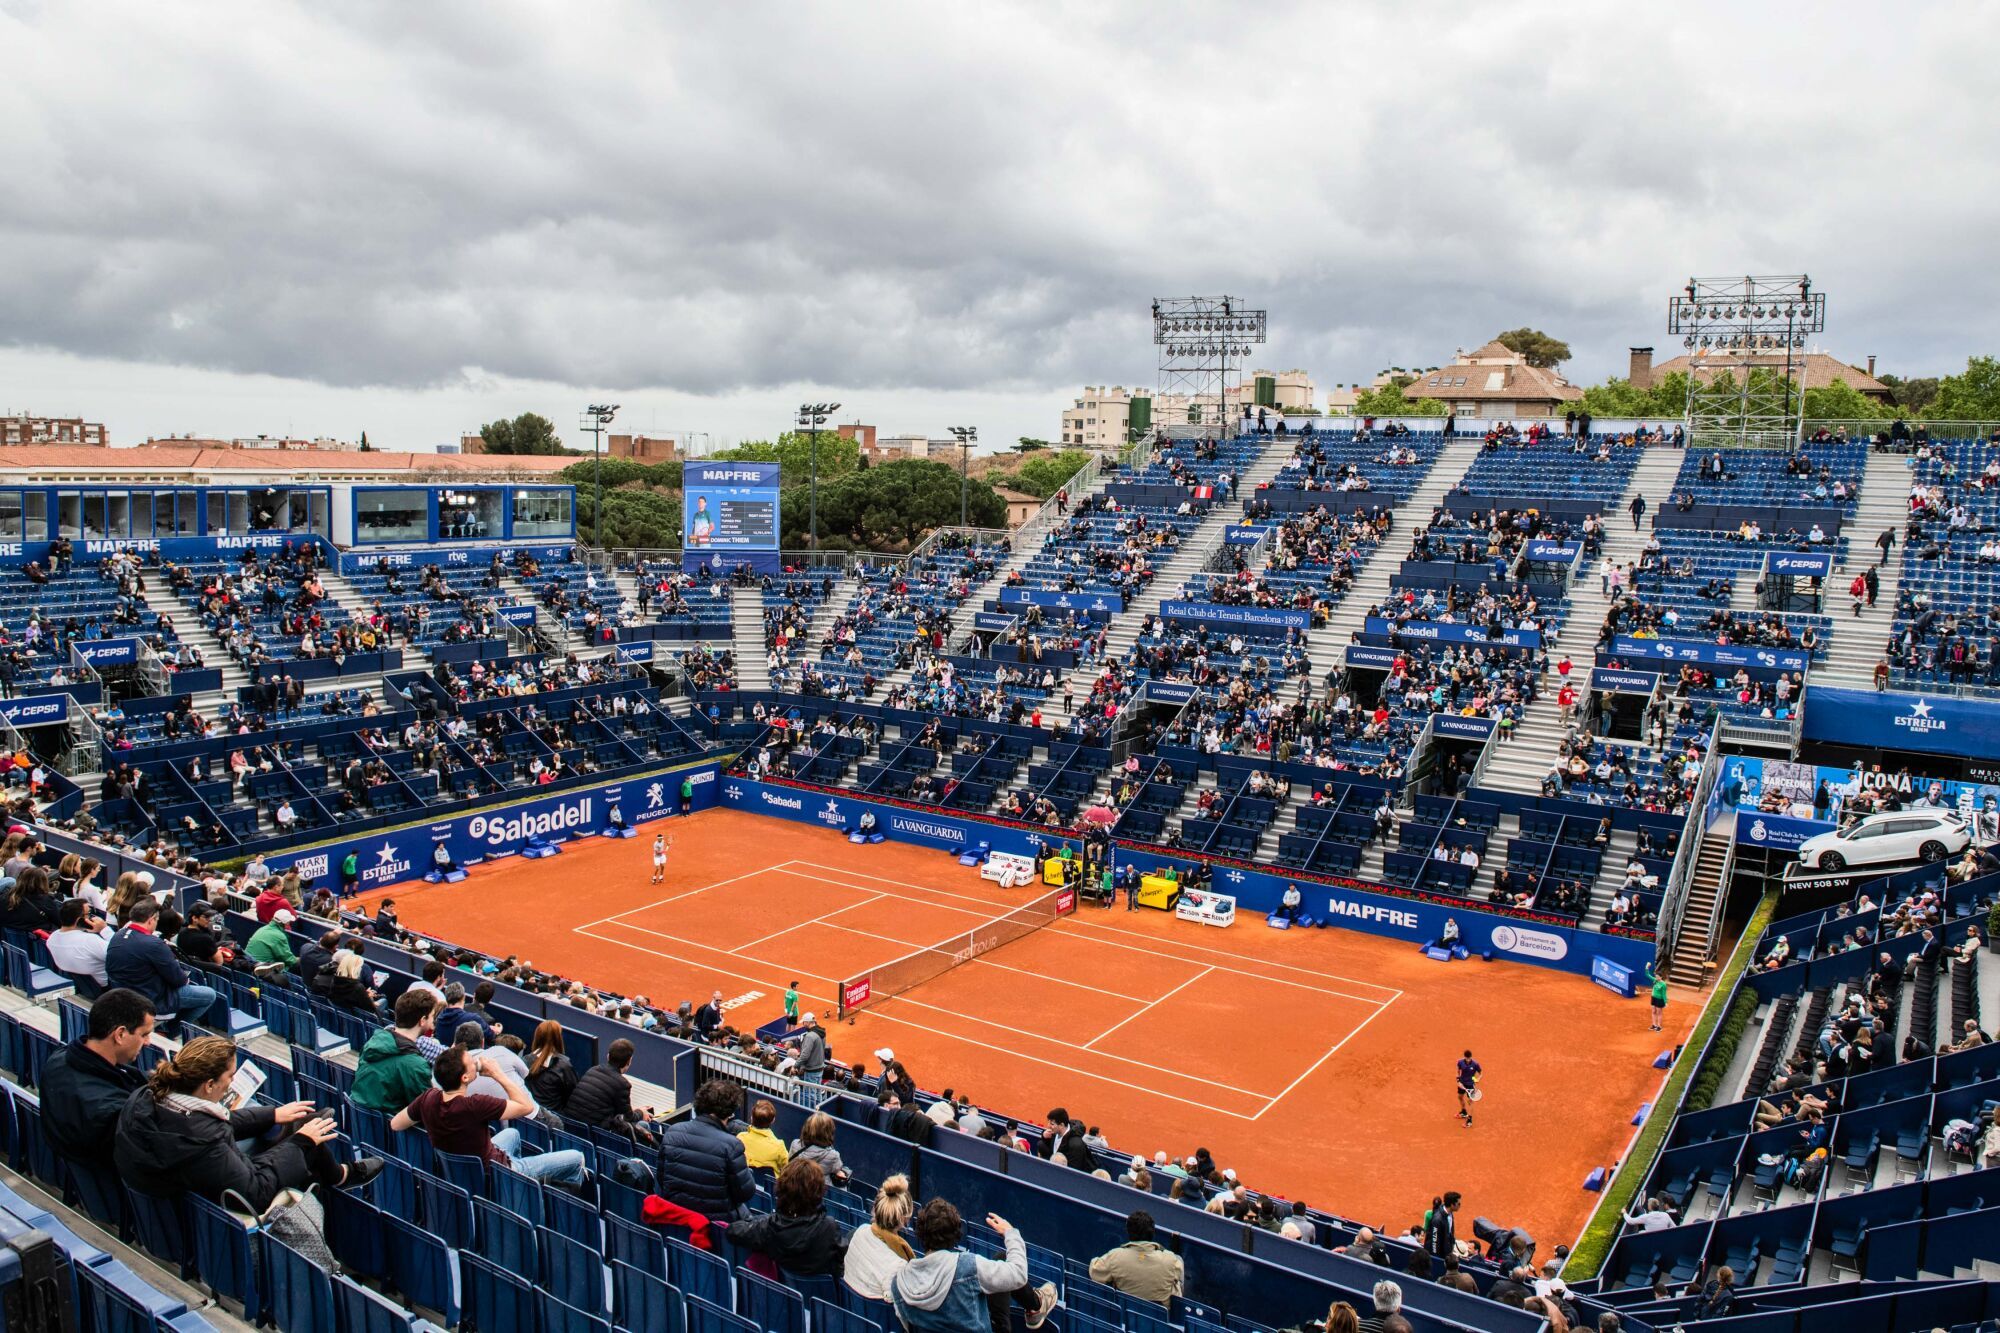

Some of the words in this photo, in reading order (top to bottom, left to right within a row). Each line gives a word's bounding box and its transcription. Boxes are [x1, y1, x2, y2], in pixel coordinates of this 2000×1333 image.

[703, 470, 760, 481] MAPFRE
[1240, 531, 1263, 539] CEPSA
[86, 539, 161, 553] MAPFRE
[217, 535, 282, 548] MAPFRE
[448, 551, 468, 562] rtve
[1546, 547, 1574, 555] CEPSA
[1790, 560, 1823, 569] CEPSA
[511, 612, 532, 621] CEPSA
[1168, 605, 1187, 616] Reial
[1187, 607, 1206, 617] Club
[1207, 609, 1216, 618] de
[1217, 609, 1242, 620] Tennis
[97, 647, 130, 658] CEPSA
[629, 647, 649, 656] CEPSA
[1680, 649, 1698, 657] ATP
[1781, 657, 1802, 665] ATP
[1609, 676, 1648, 685] VANGUARDIA
[1159, 689, 1190, 698] VANGUARDIA
[22, 704, 59, 716] CEPSA
[1449, 722, 1488, 732] VANGUARDIA
[1894, 716, 1946, 730] ESTRELLA
[1763, 776, 1812, 790] BARCELONA
[1859, 771, 1912, 793] ICONA
[1912, 777, 1960, 796] FUUR
[768, 794, 801, 810] Sabadell
[636, 807, 673, 821] PEUGEOT
[818, 811, 846, 823] ESTRELLA
[487, 797, 592, 845] Sabadell
[893, 819, 906, 830] LA
[905, 820, 963, 841] VANGUARDIA
[296, 855, 327, 869] MARY
[362, 860, 411, 880] ESTRELLA
[1789, 881, 1812, 890] NEW
[1813, 880, 1832, 888] 508
[1329, 898, 1418, 929] MAPFRE
[1520, 934, 1549, 945] Ajuntament
[1519, 940, 1556, 953] Barcelona
